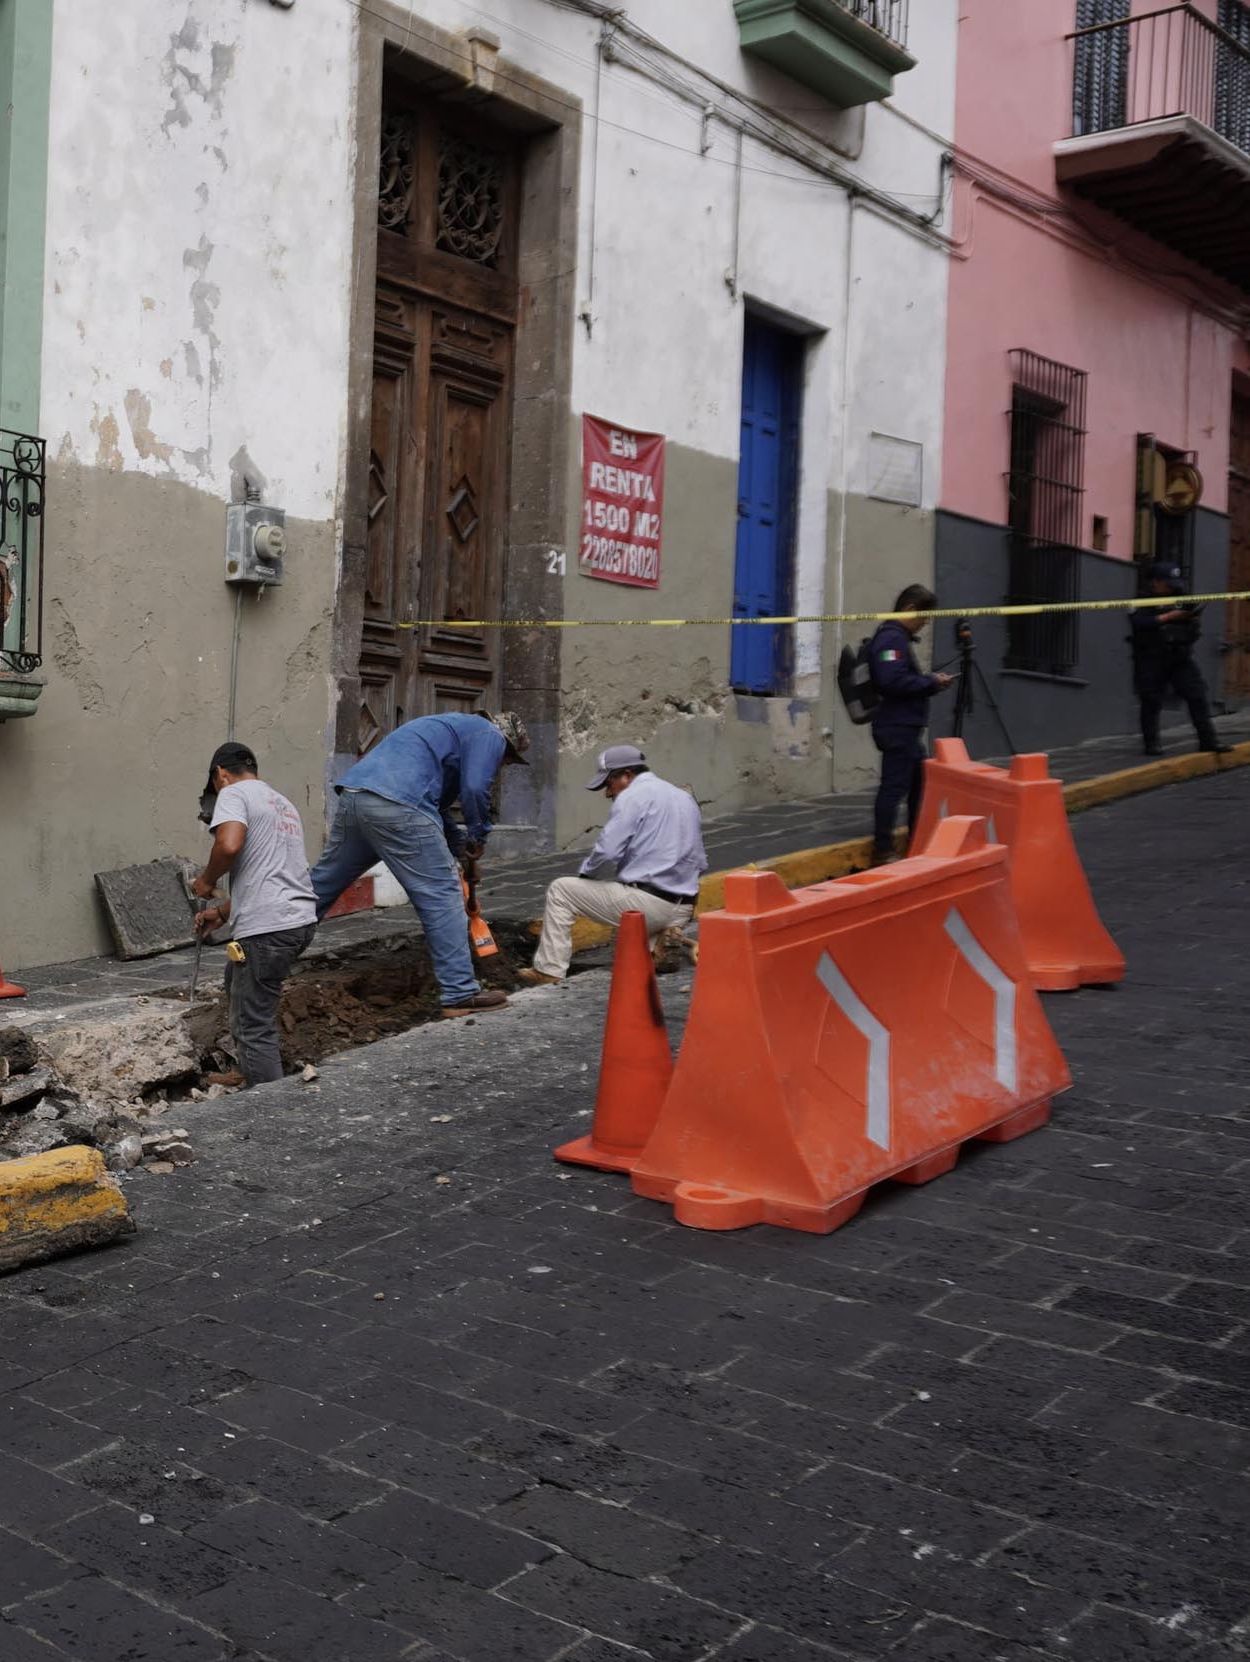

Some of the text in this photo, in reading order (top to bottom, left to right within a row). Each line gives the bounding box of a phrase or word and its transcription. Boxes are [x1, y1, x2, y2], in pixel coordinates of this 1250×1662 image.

[609, 430, 638, 460] EN
[590, 461, 656, 502] RENTA
[584, 499, 660, 541] 1500 M2
[548, 550, 567, 576] 21
